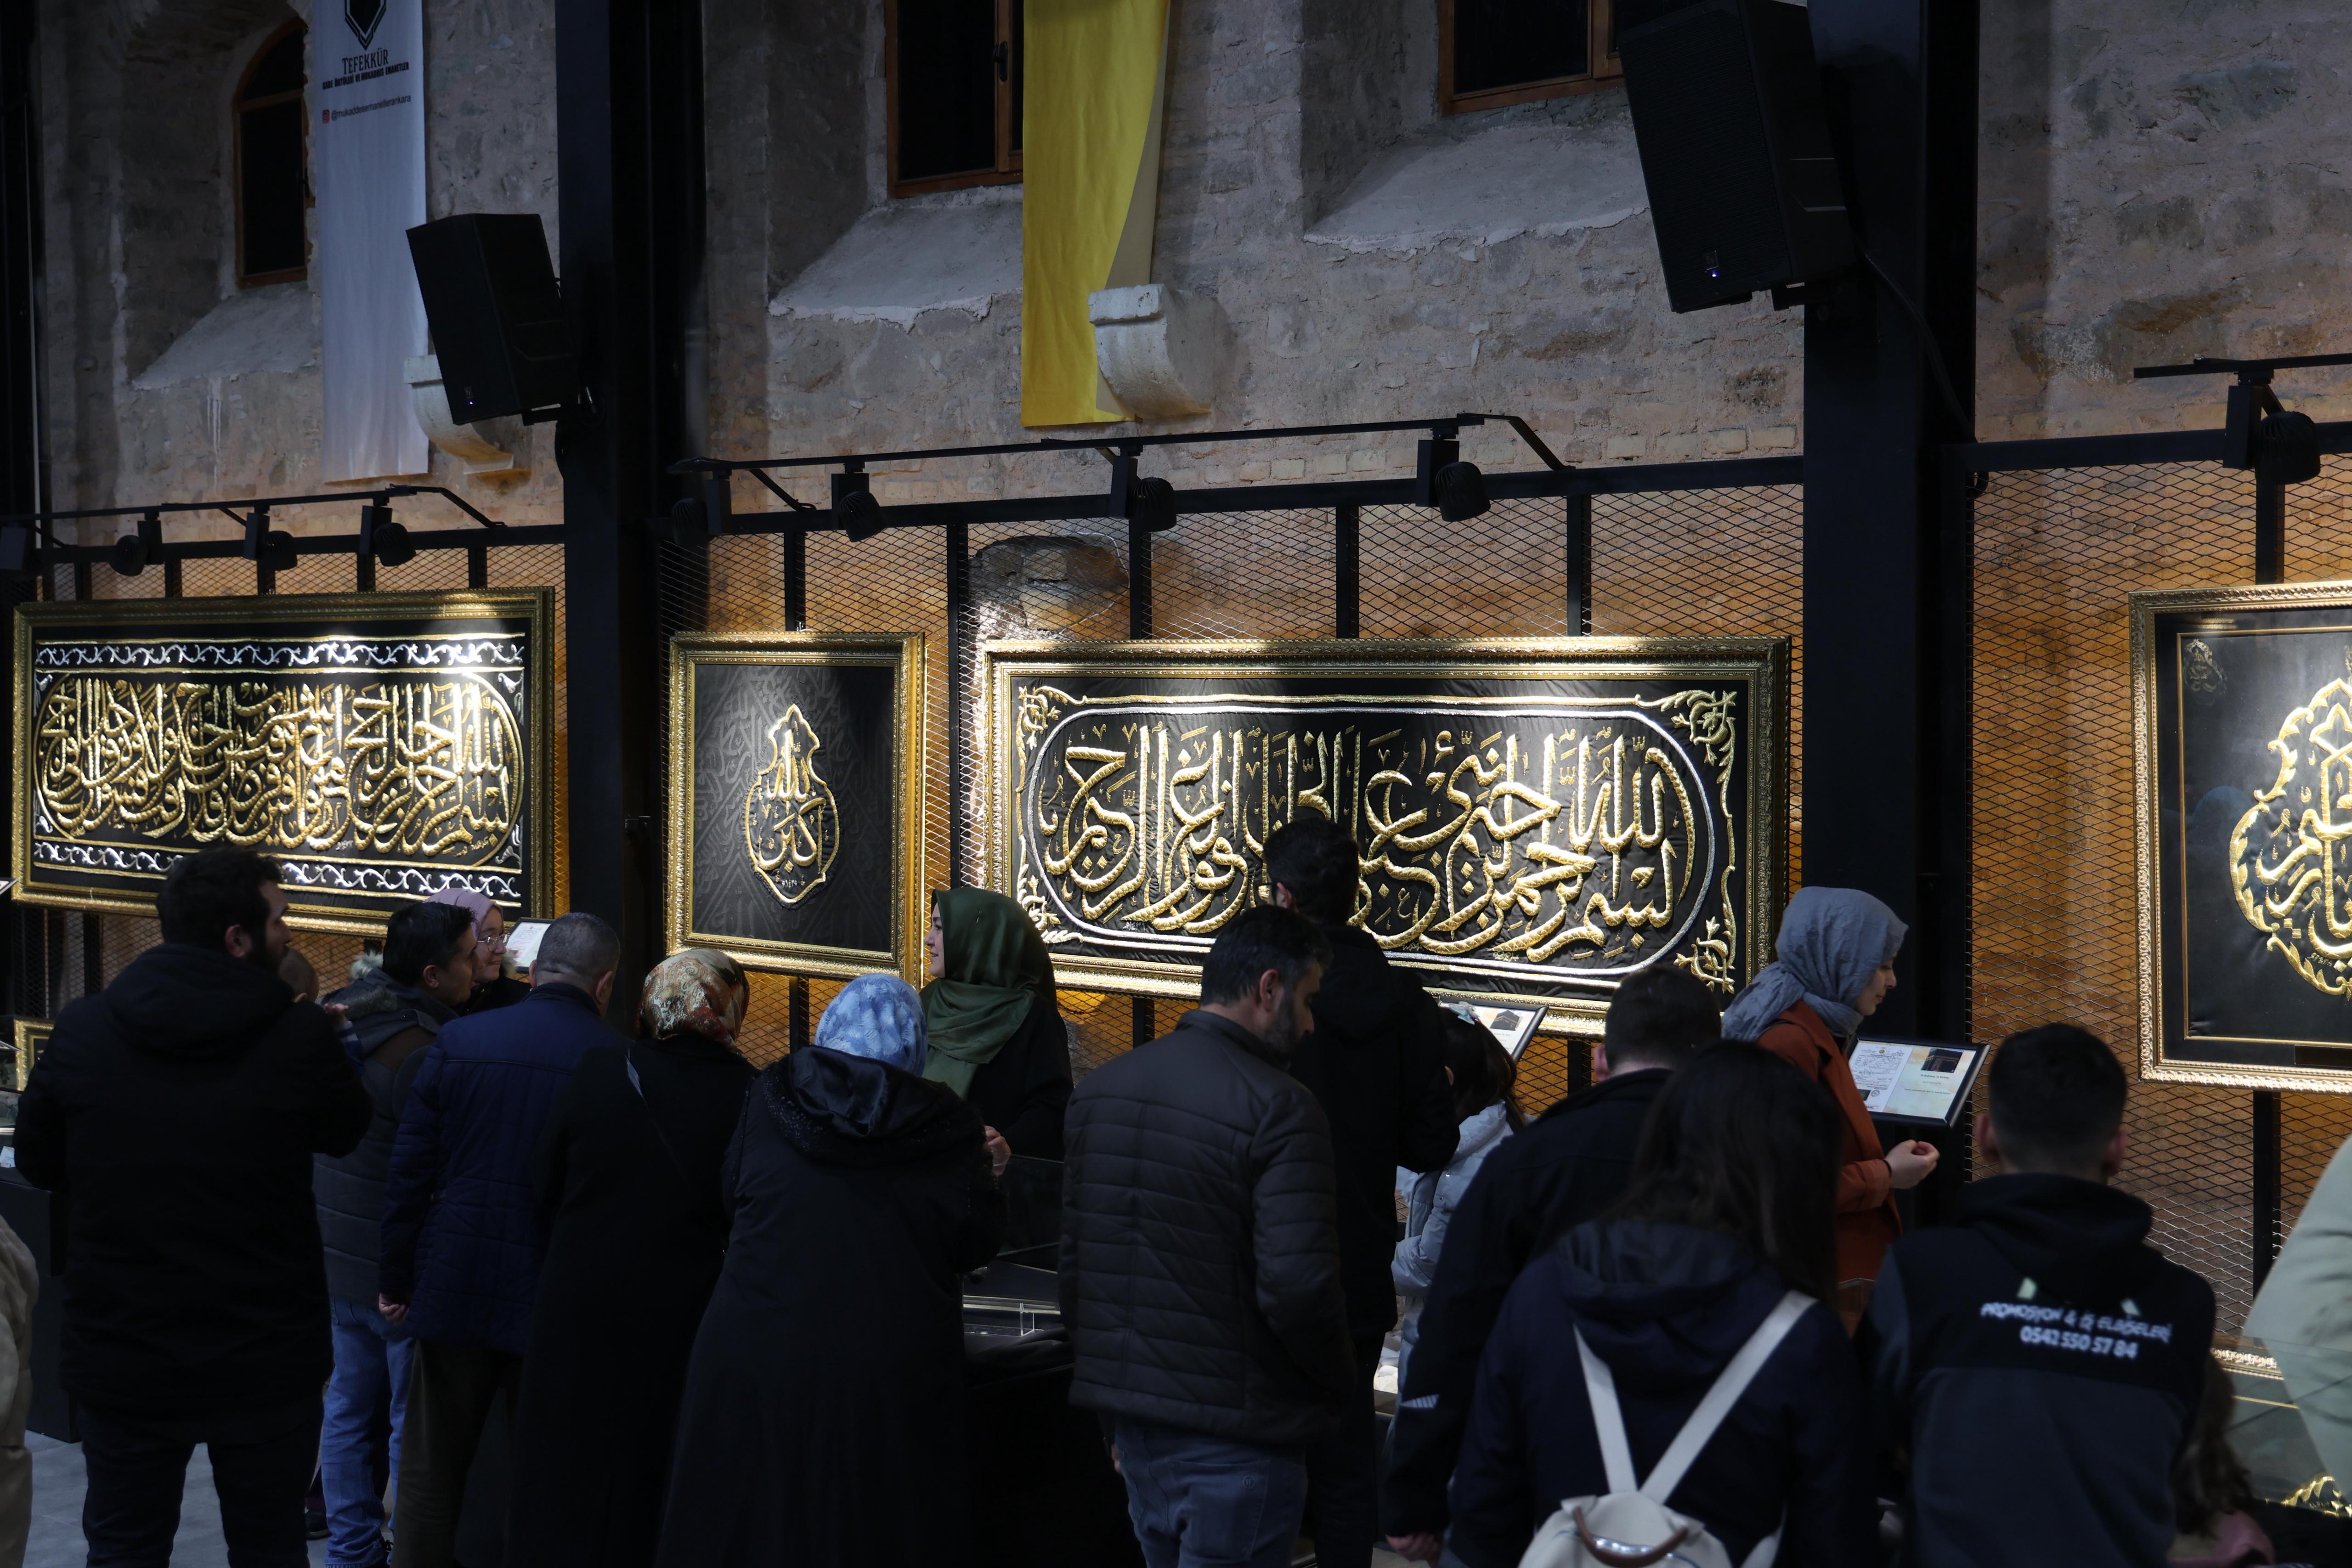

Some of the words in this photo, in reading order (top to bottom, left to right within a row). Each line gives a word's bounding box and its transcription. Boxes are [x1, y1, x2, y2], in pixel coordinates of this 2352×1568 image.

[342, 47, 388, 74] TEFEKKÜR
[355, 73, 360, 82] VE
[361, 68, 384, 80] MUKADDES
[385, 62, 409, 74] EMANETLER
[2064, 1309, 2077, 1327] &
[2060, 1331, 2091, 1351] 550
[2091, 1335, 2113, 1355] 57
[2113, 1339, 2139, 1360] 84
